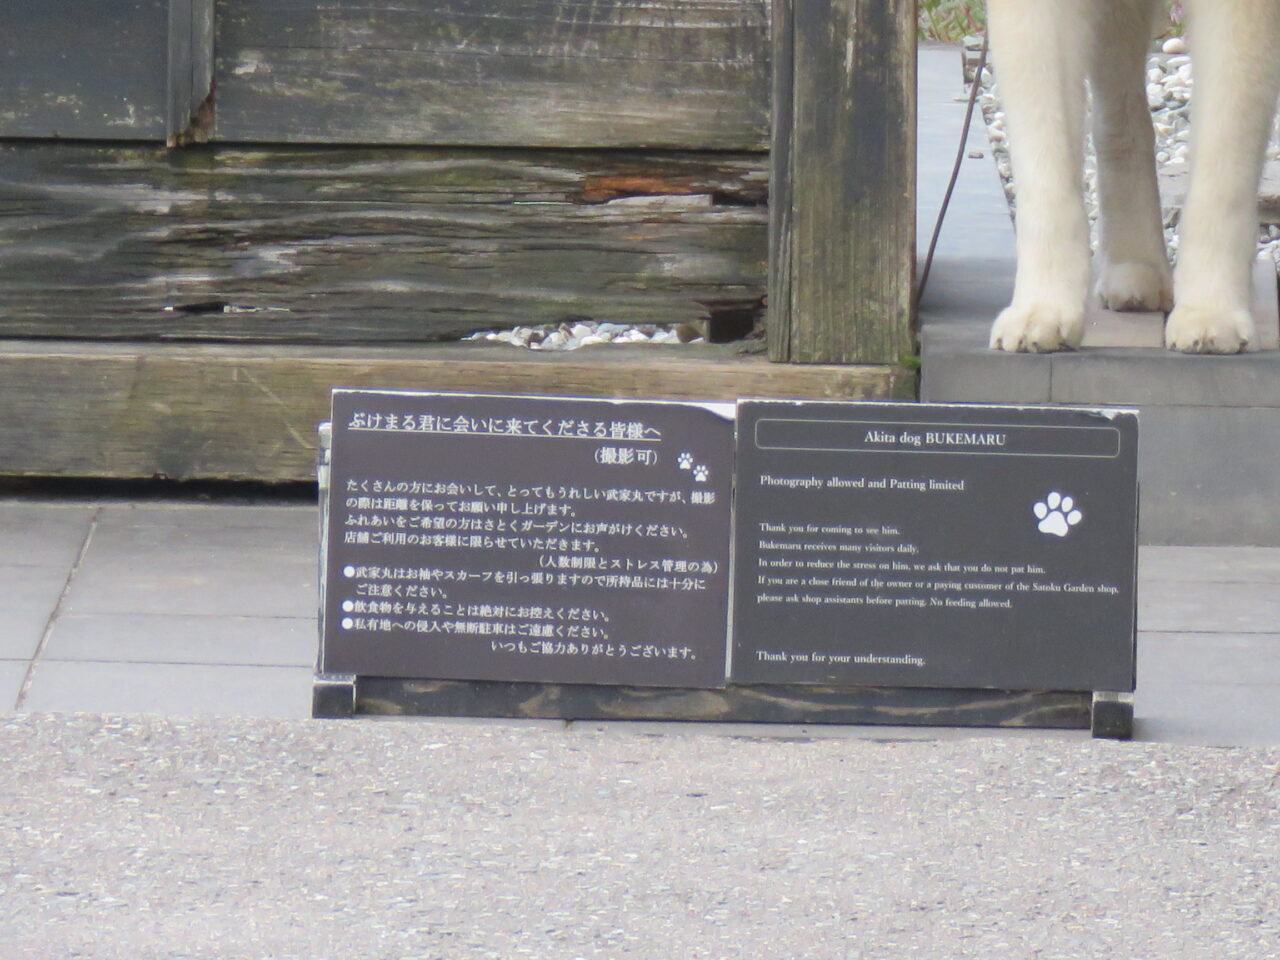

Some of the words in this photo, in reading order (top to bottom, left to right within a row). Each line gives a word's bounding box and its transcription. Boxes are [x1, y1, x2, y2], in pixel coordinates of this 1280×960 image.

[864, 430, 895, 442] Akita
[899, 431, 921, 446] dog
[926, 432, 1006, 445] BUKEMARU
[760, 475, 823, 489] Photography
[826, 477, 864, 487] allowed
[867, 478, 886, 488] and
[890, 478, 926, 492] Patting
[929, 479, 964, 490] limited
[759, 522, 786, 531] Thank
[788, 526, 804, 534] you
[806, 524, 819, 532] for
[820, 525, 852, 536] coming
[881, 526, 900, 534] him.
[759, 540, 802, 549] Bukemaru
[803, 542, 837, 550] receives
[839, 544, 861, 553] many
[864, 543, 895, 552] visitors
[758, 558, 768, 566] In
[769, 558, 792, 567] order
[806, 559, 834, 568] reduce
[836, 559, 850, 568] the
[927, 562, 941, 571] ask
[943, 562, 960, 571] that
[963, 565, 978, 574] you
[980, 563, 992, 572] do
[1011, 566, 1024, 575] pat
[1026, 564, 1045, 573] him.
[758, 575, 765, 584] If
[767, 578, 783, 586] you
[808, 576, 829, 585] close
[831, 577, 857, 586] friend
[858, 578, 868, 586] of
[870, 578, 884, 588] the
[934, 582, 962, 591] paying
[1004, 582, 1014, 590] of
[1016, 582, 1030, 590] the
[1032, 582, 1061, 591] Satoku
[1063, 583, 1094, 592] Garden
[756, 592, 783, 604] please
[785, 593, 799, 602] ask
[801, 594, 822, 605] shop
[823, 595, 864, 604] assistants
[866, 595, 893, 604] before
[930, 597, 943, 606] No
[945, 597, 976, 609] feeding
[756, 650, 787, 661] Thank
[790, 654, 808, 664] you
[811, 652, 826, 661] for
[828, 655, 851, 665] your
[854, 653, 926, 667] understanding.
